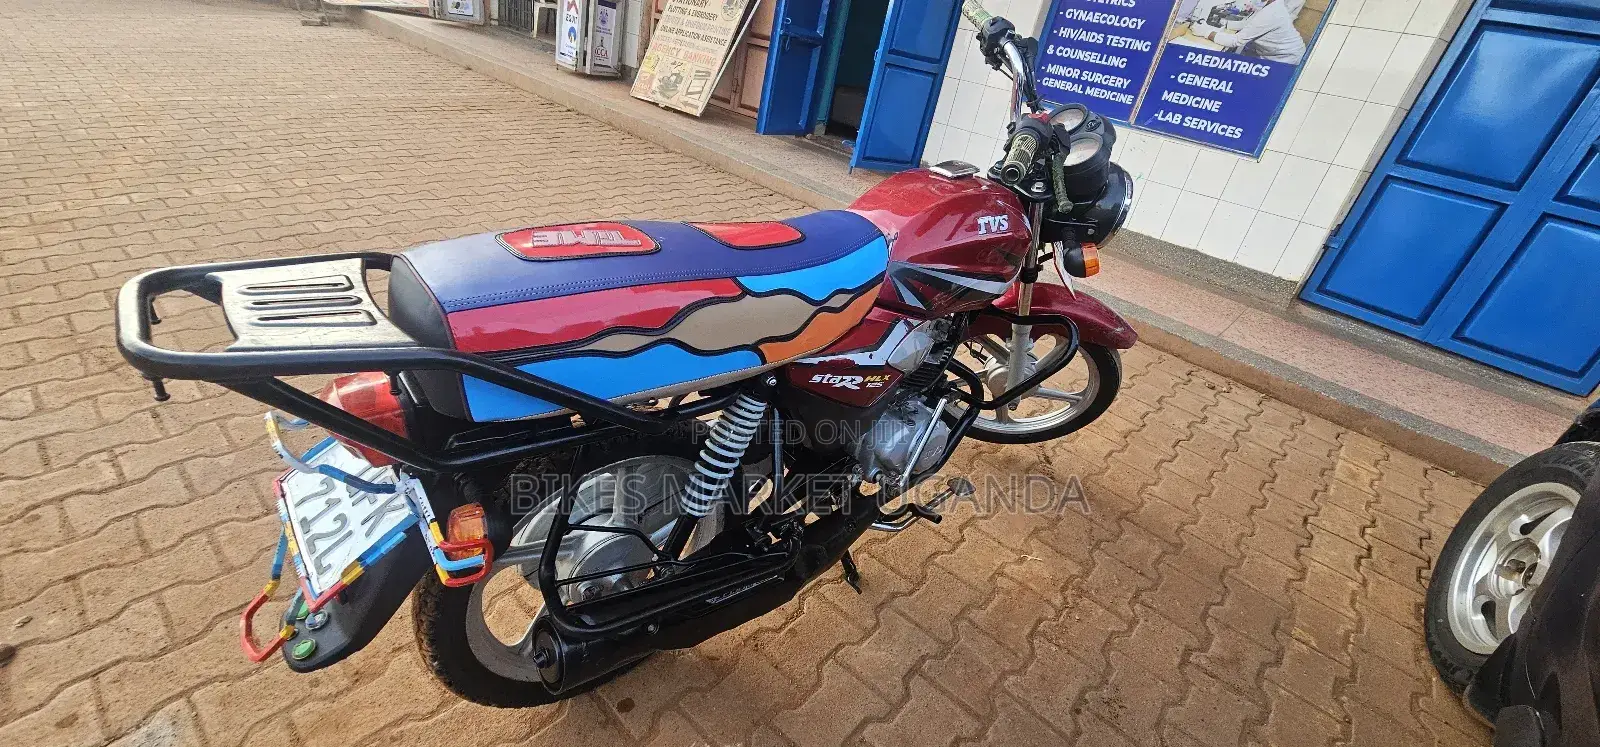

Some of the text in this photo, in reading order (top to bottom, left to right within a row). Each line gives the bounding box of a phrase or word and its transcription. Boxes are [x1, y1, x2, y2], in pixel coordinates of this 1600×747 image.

[1065, 8, 1146, 30] GYNAECOLOGY
[1058, 27, 1105, 44] HIV/AIDS
[1106, 34, 1152, 52] TESTING
[651, 42, 680, 56] AGENCY
[683, 51, 717, 67] BANKING
[1047, 44, 1128, 69] & COUNSELLING
[1185, 52, 1271, 77] PAEDIATRICS
[1046, 63, 1081, 80] MINOR
[1081, 70, 1131, 89] SURGERY
[1177, 72, 1234, 94] GENERAL
[1042, 76, 1084, 94] GENERAL
[1084, 86, 1134, 105] MEDICINE
[1161, 90, 1222, 113] MEDICINE
[1182, 116, 1243, 139] SERVICES
[977, 215, 1009, 235] TVS
[863, 374, 892, 382] HLX
[294, 477, 354, 576] 712L
